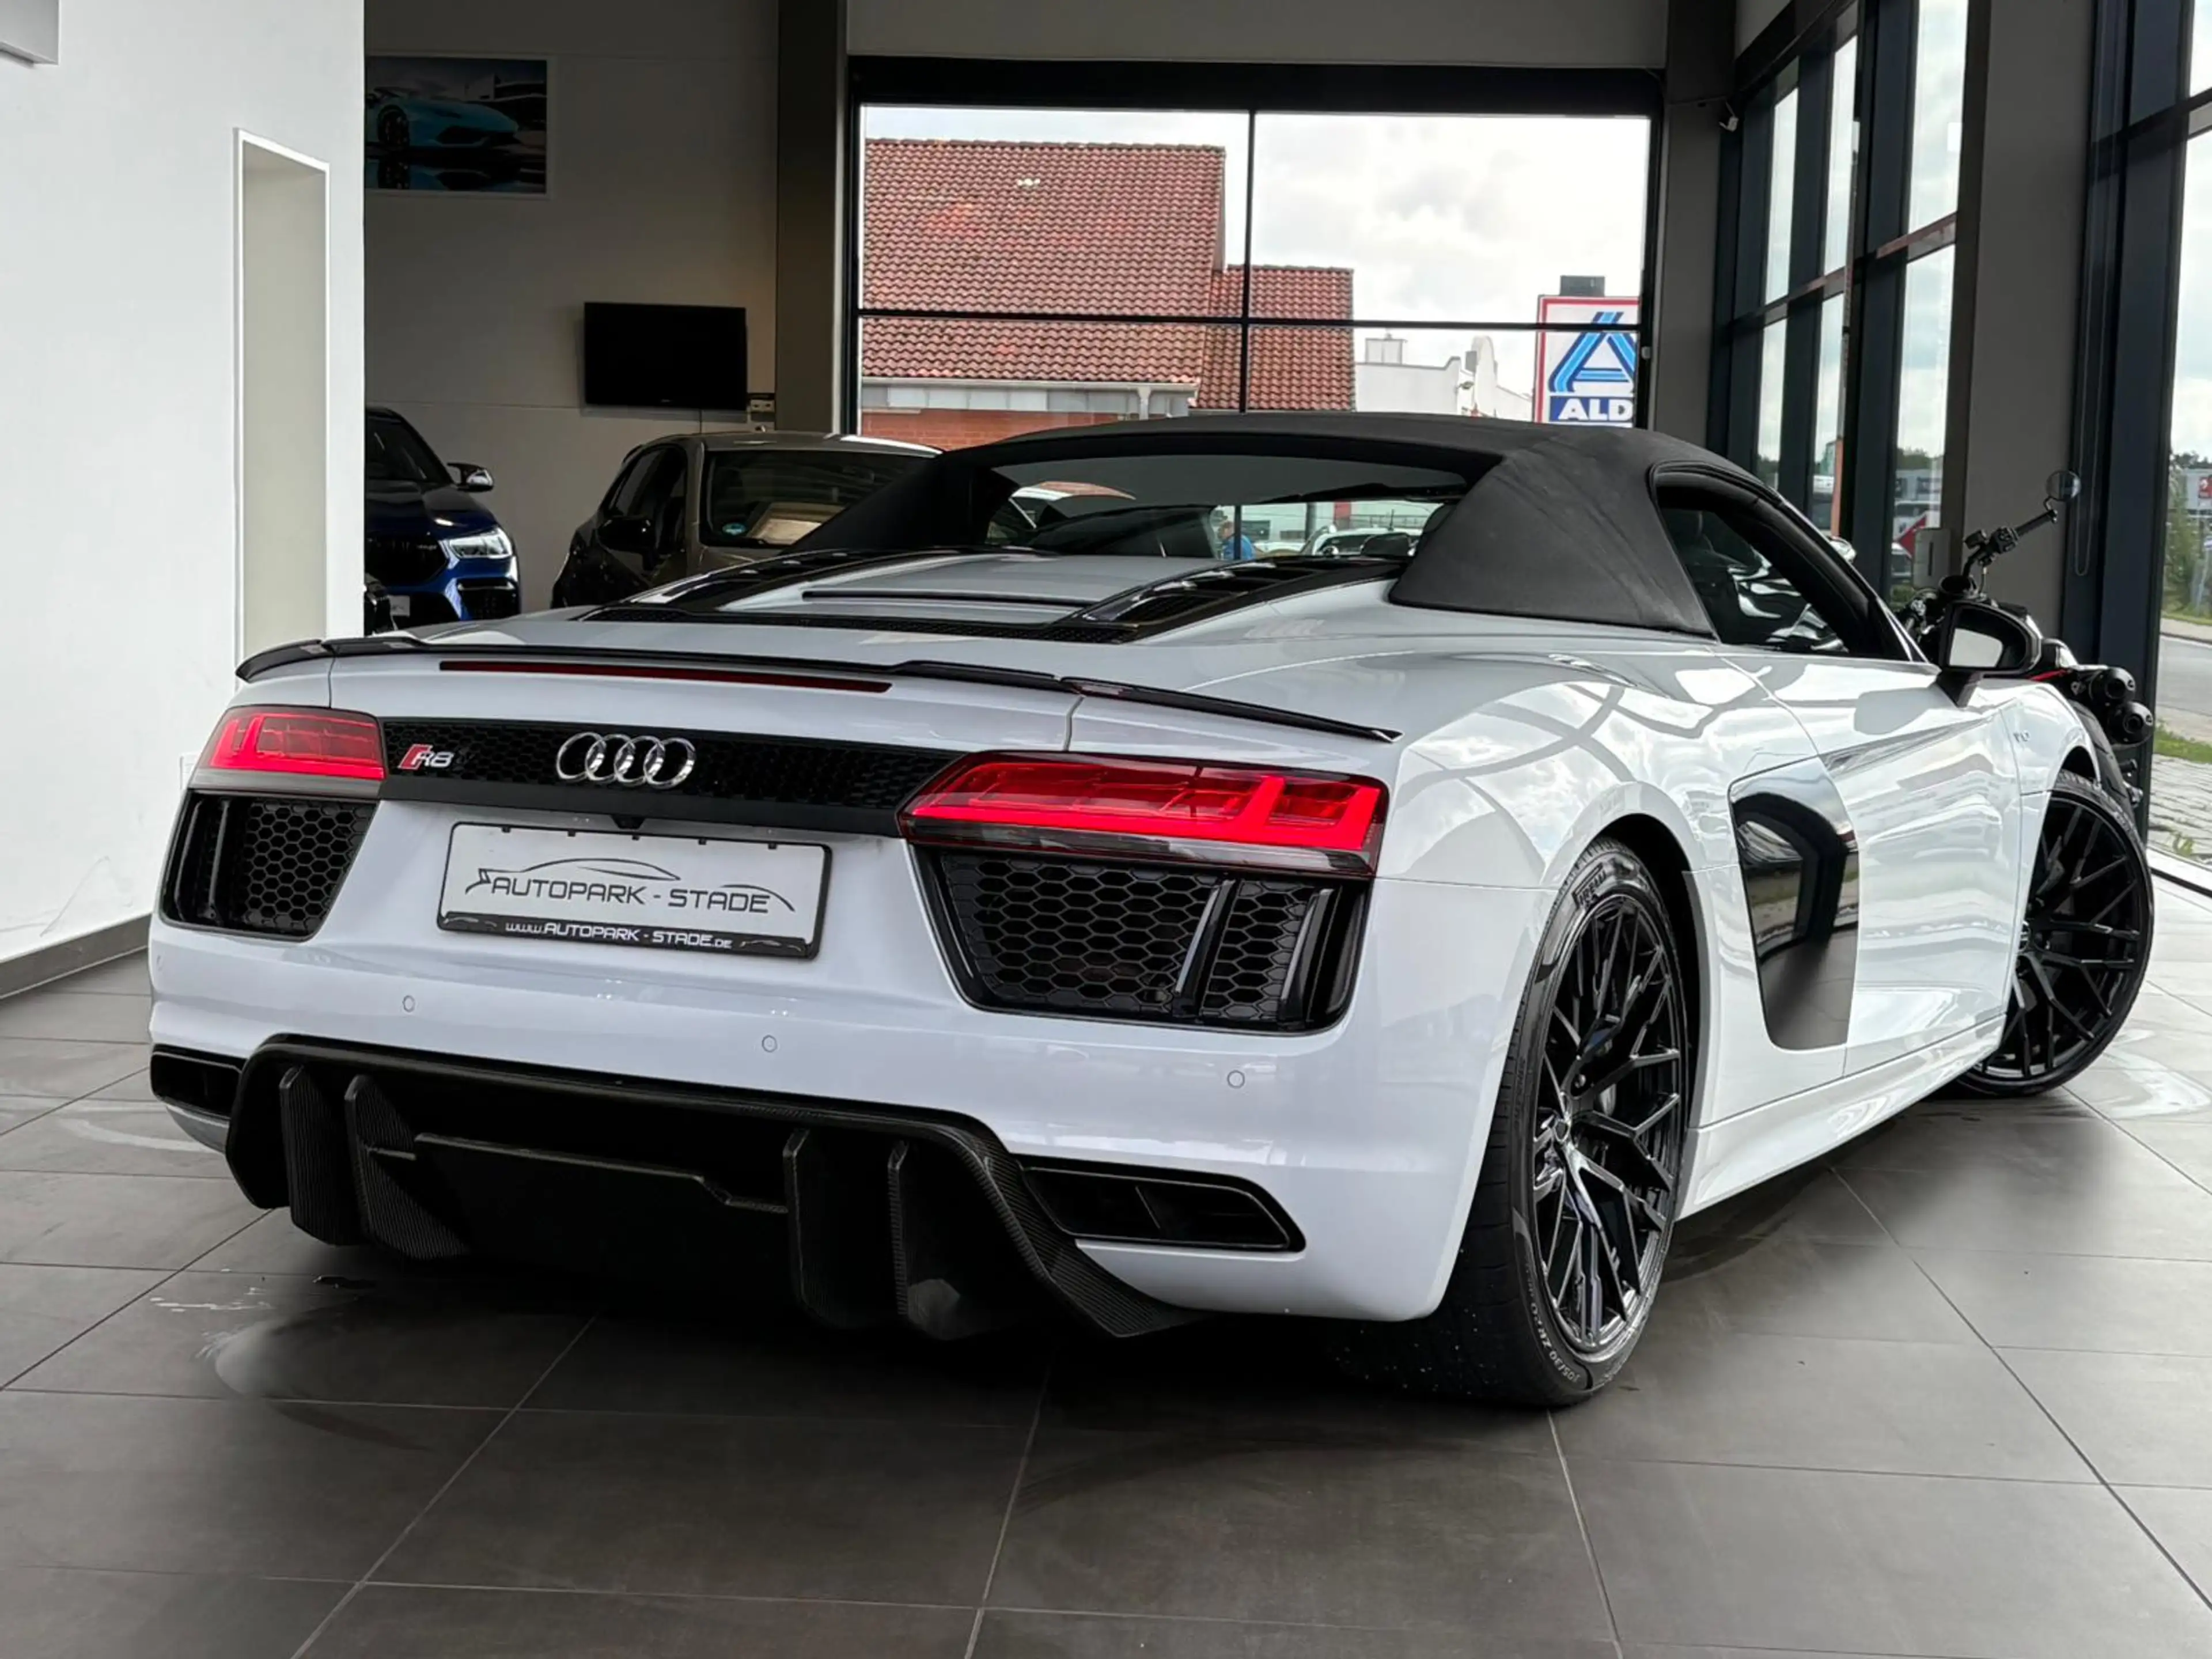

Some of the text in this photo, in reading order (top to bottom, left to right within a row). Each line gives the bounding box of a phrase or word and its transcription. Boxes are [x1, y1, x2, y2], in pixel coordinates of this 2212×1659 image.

[397, 744, 454, 770] R8
[491, 876, 646, 905] AUTOPARK
[668, 888, 771, 914] STADE
